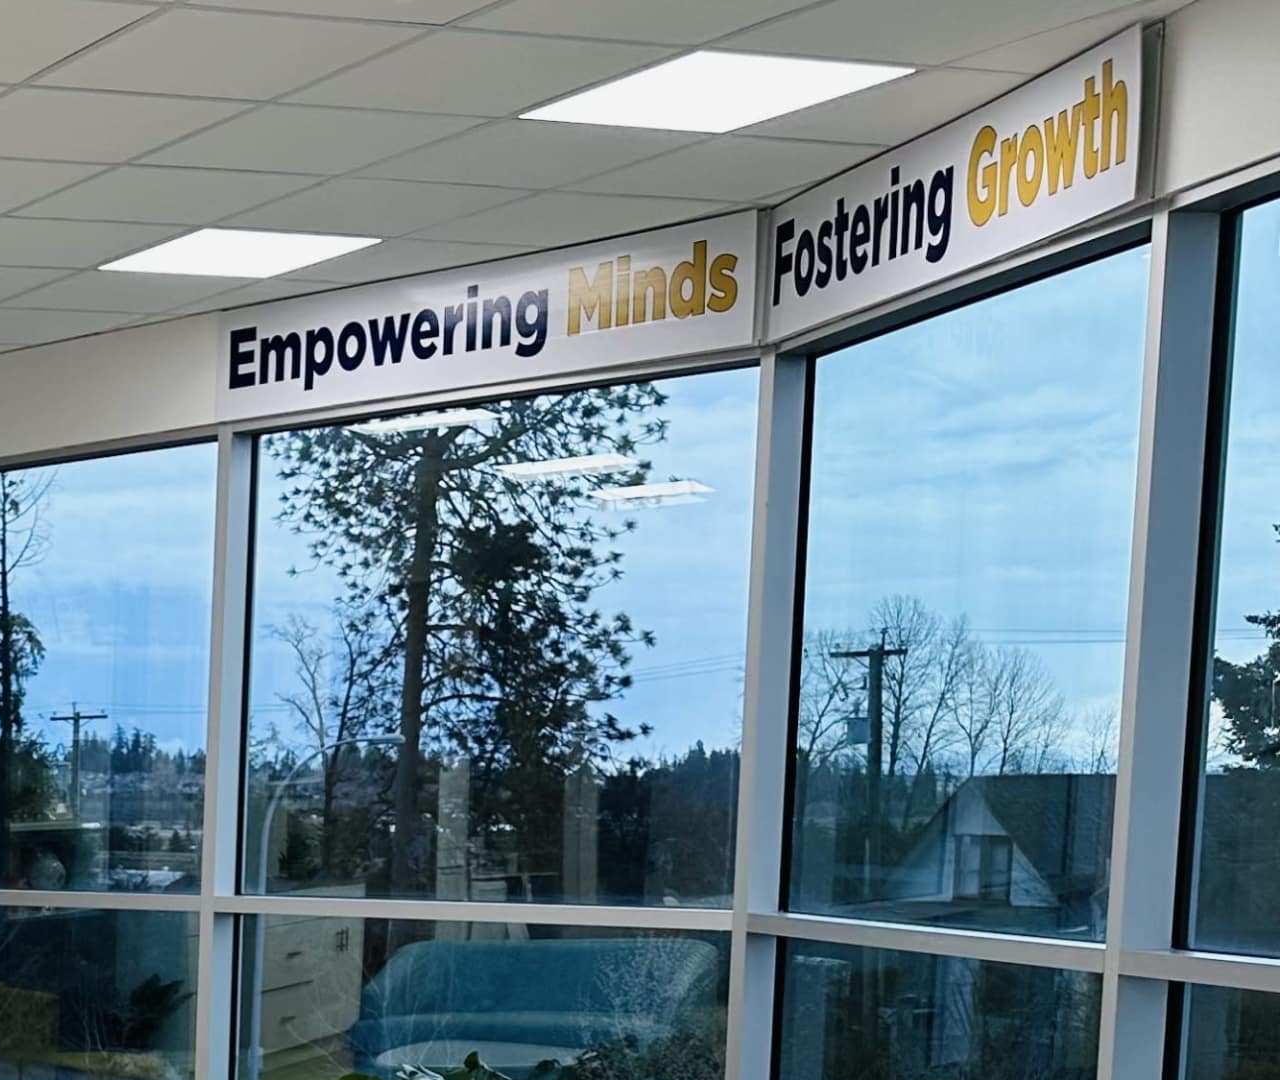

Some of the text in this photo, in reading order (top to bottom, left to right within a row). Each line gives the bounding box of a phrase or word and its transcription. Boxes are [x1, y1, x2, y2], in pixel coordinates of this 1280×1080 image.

[773, 58, 1129, 307] Fostering Growth
[228, 239, 739, 391] Empowering Minds
